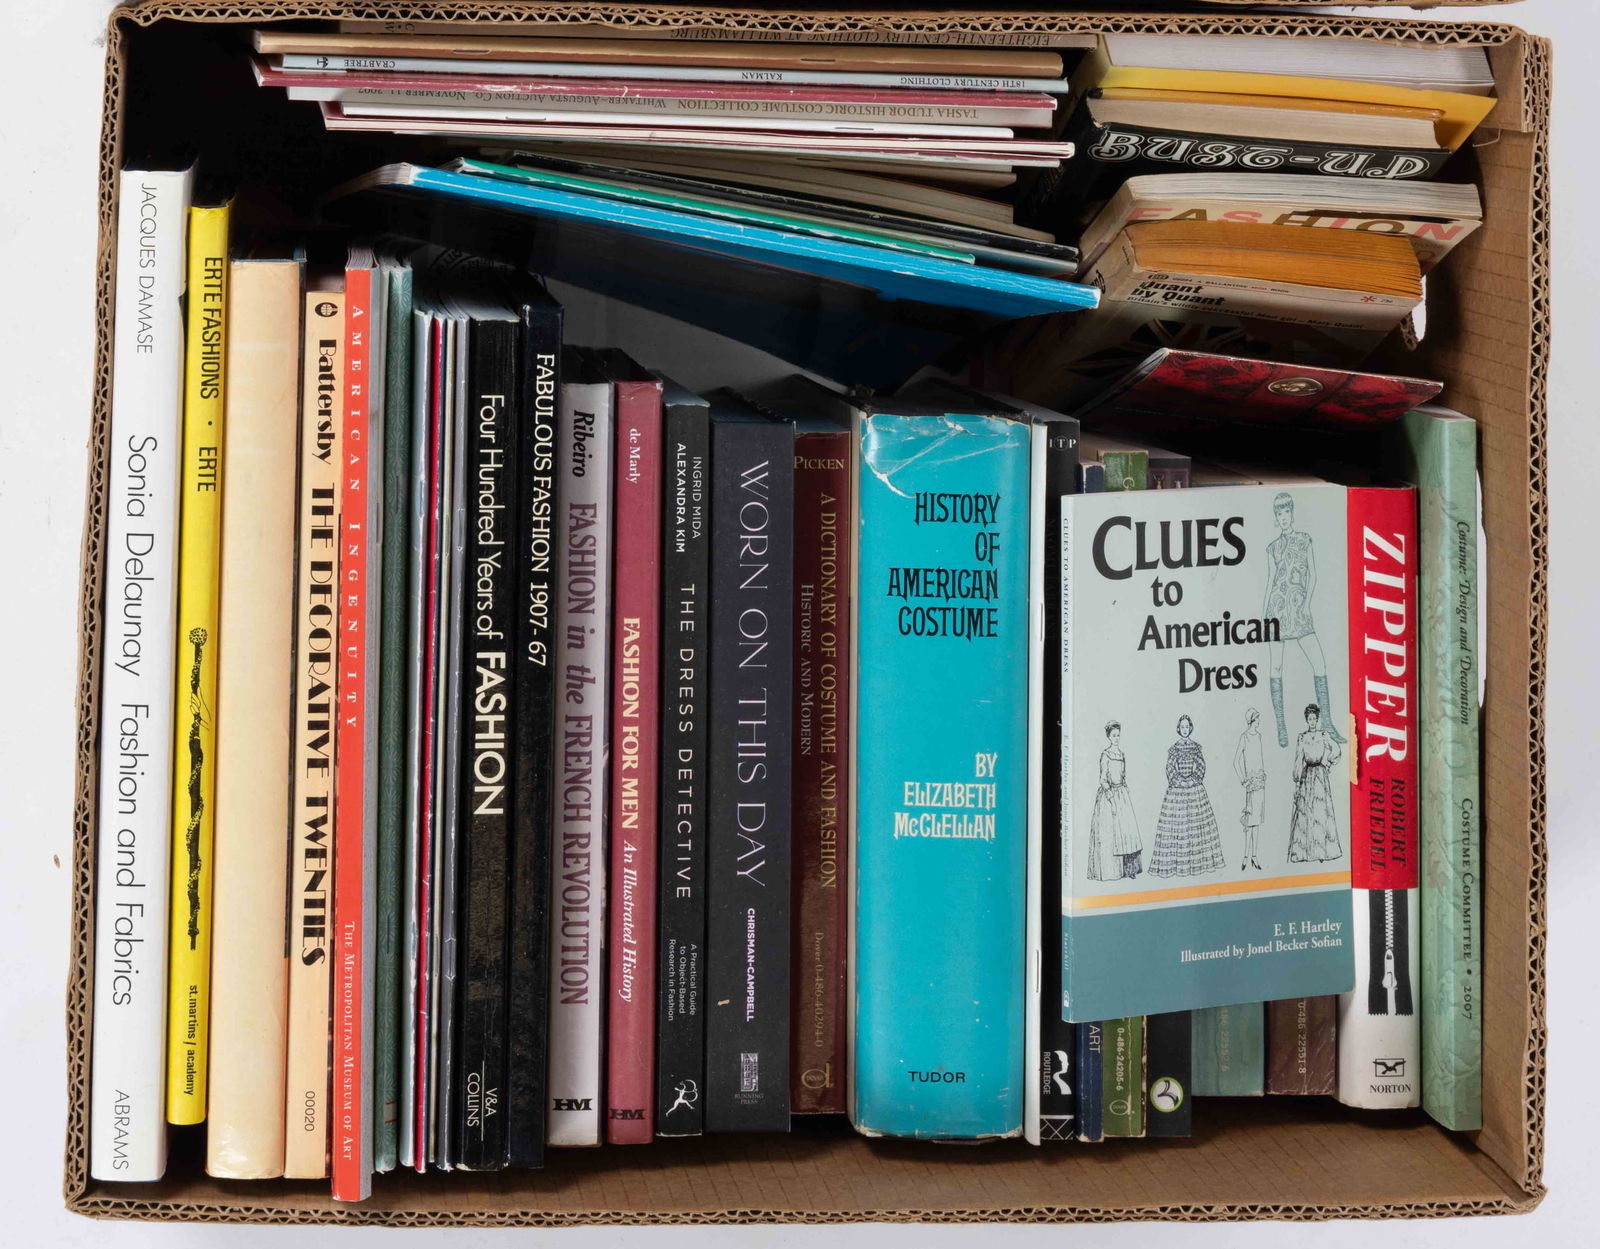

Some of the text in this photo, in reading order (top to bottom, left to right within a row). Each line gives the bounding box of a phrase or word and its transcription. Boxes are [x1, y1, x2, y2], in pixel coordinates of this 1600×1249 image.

[344, 60, 396, 68] CRABTREE
[955, 80, 1000, 88] CENTURY
[676, 443, 686, 552] ALEXANDRA KIM
[692, 456, 702, 539] INGRID MIDA
[914, 492, 1000, 527] HISTORY
[975, 531, 1000, 564] OF
[1092, 515, 1246, 580] CLUES
[473, 394, 506, 815] Four Hundred Years of FASHION
[888, 568, 999, 600] AMERICAN
[1151, 577, 1183, 607] to
[898, 606, 998, 638] COSTUME
[1138, 611, 1280, 651] American
[1362, 526, 1408, 762] ZIPPER
[112, 183, 158, 1170] JACQUES DAMASE Sonia Delaunay Fashion and Fabrics ABRAMS
[301, 339, 337, 966] Battersby THE DECORATIVE TWENTIES
[737, 460, 768, 887] WORN ON THIS DAY
[1178, 658, 1258, 693] Dress
[560, 410, 597, 1005] Ribeiro FASHION in the FRENCH REVOLUTION
[1369, 778, 1386, 872] FRIEDEL
[1390, 778, 1407, 867] ROBERT
[1461, 797, 1475, 1020] COSTUME COMMITTEE 2007
[747, 908, 755, 1021] CHRISMAN-CAMPBELL
[1181, 935, 1342, 963] Illustrated by Jonel Becker Sofian
[908, 1071, 966, 1084] TUDOR
[1043, 1052, 1052, 1094] ROUTLEDGE
[1116, 1028, 1124, 1091] 0-486-24205-6
[466, 1073, 480, 1126] COLLINS
[484, 1088, 497, 1116] V&A
[1370, 1084, 1411, 1094] NORTON
